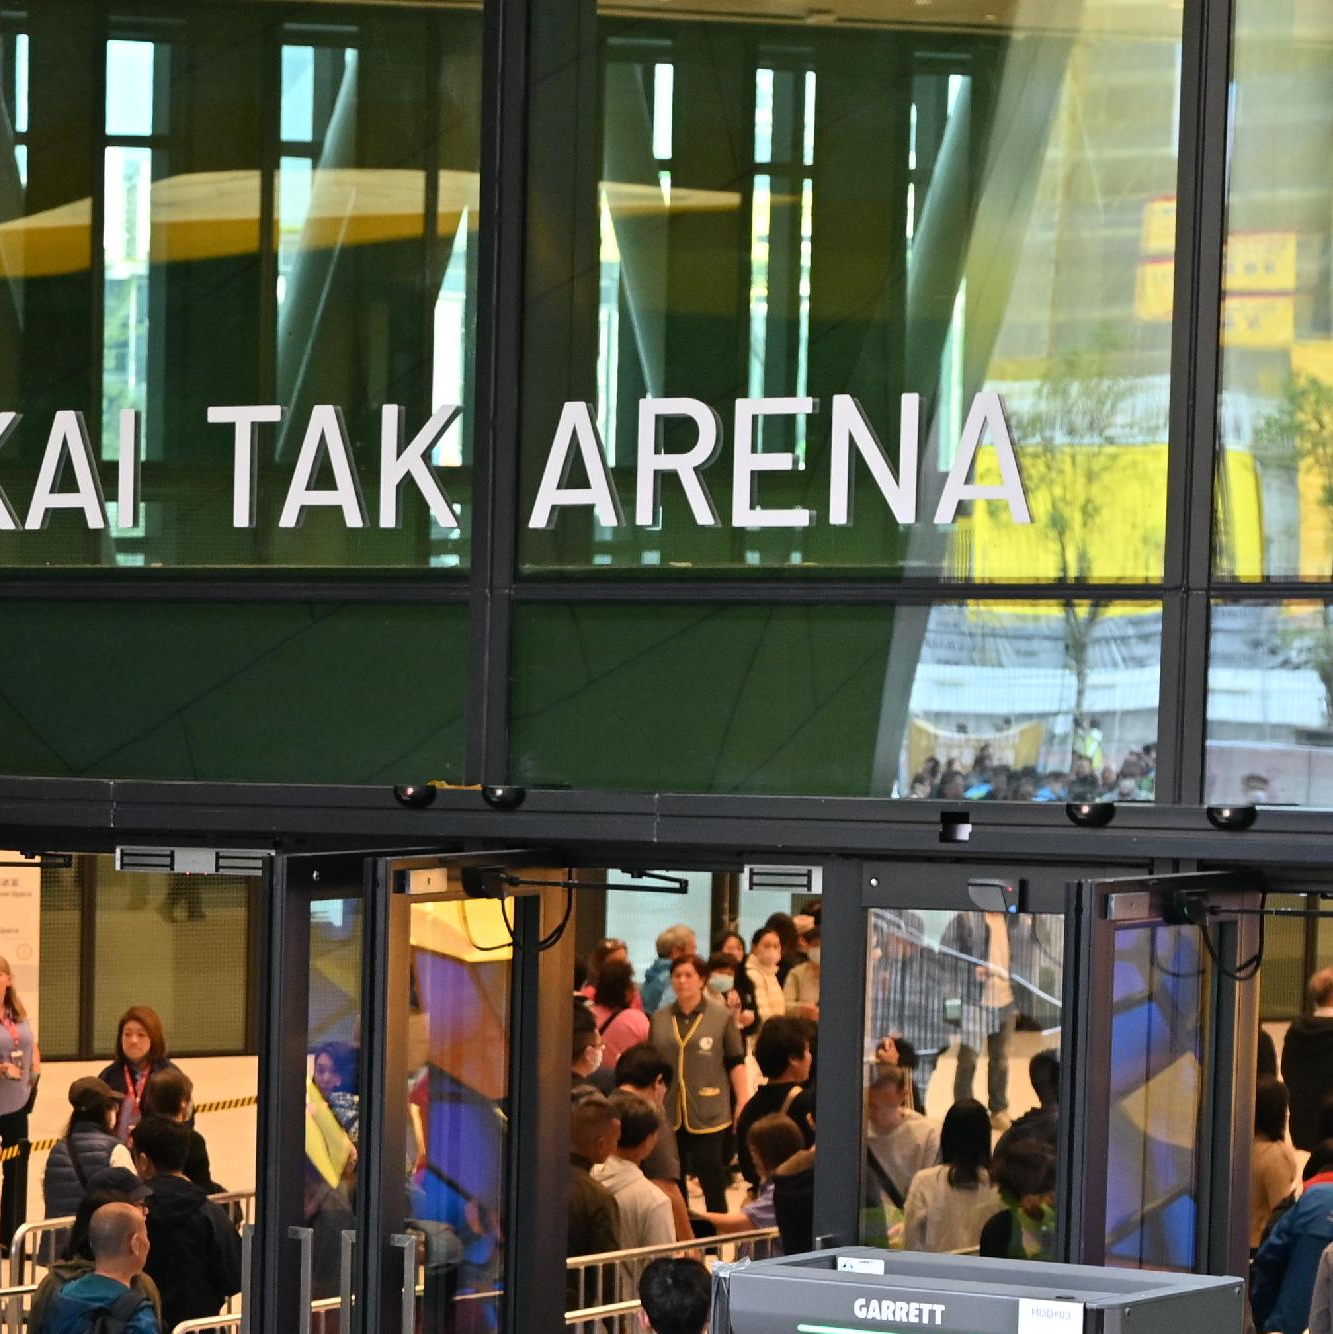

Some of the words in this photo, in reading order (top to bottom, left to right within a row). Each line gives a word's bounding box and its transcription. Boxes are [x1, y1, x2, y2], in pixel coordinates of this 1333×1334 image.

[206, 403, 460, 529] TAK
[528, 392, 1031, 528] ARENA
[853, 1298, 945, 1325] GARRETT
